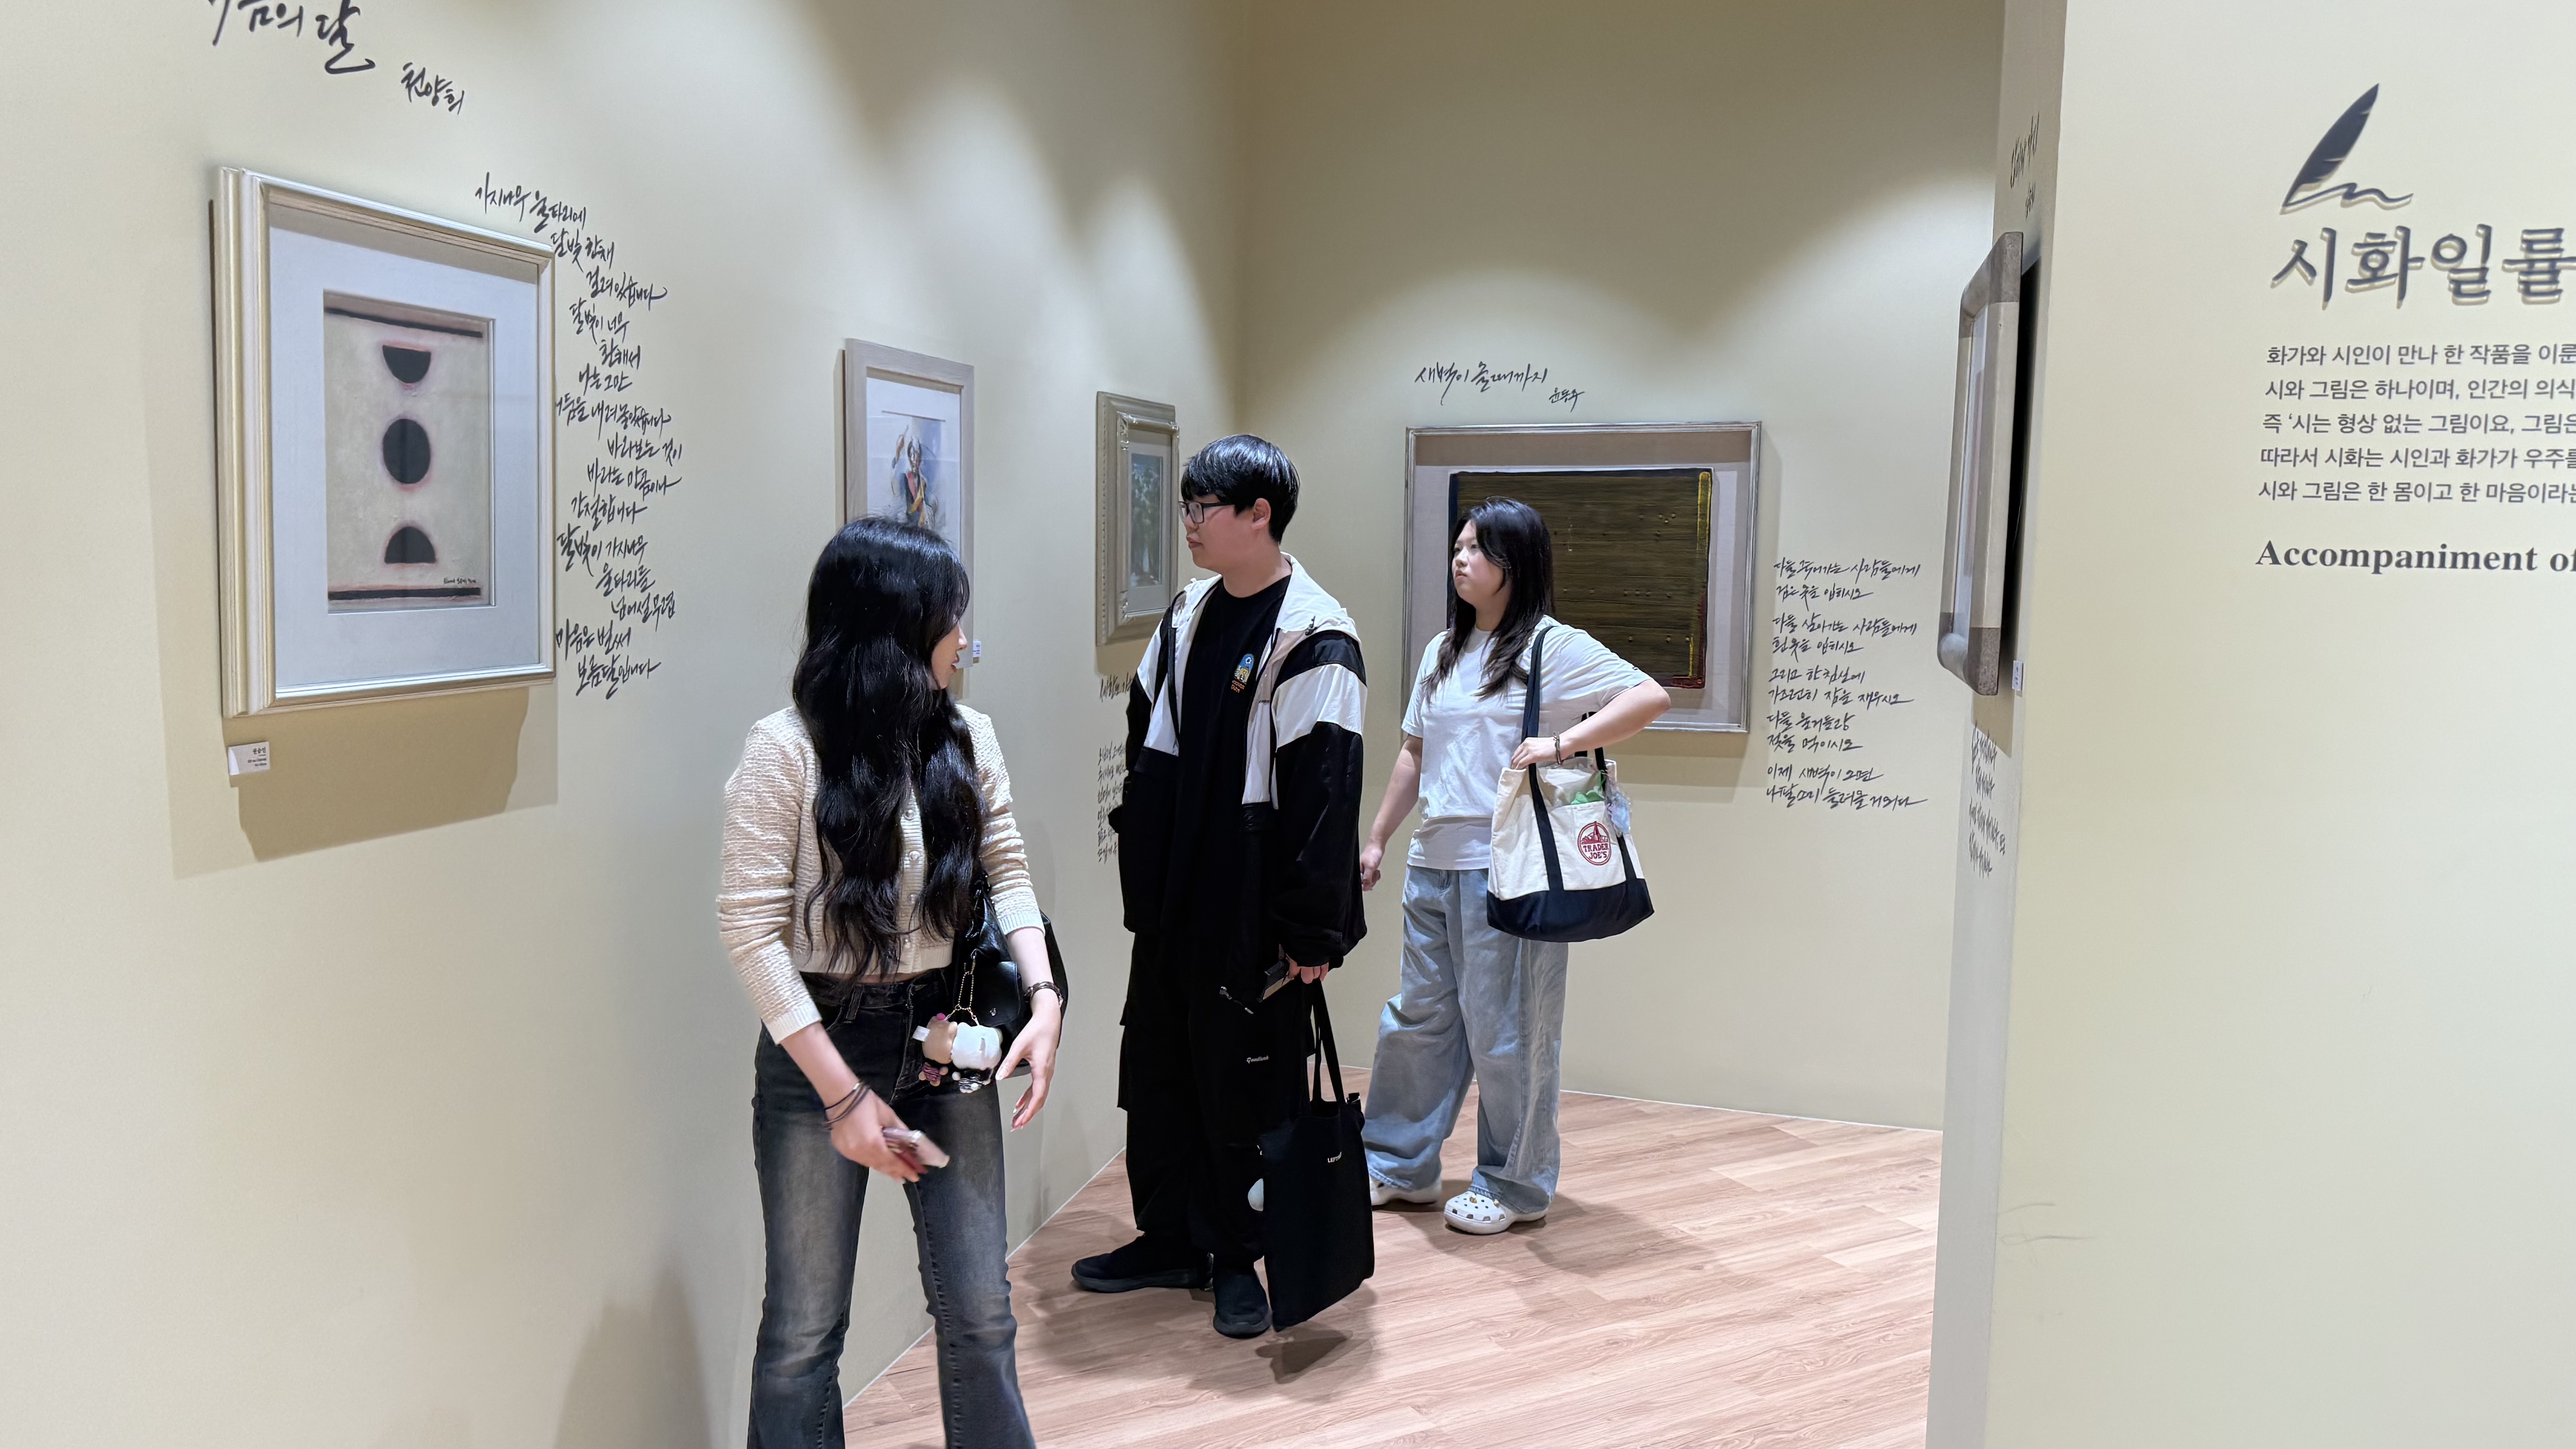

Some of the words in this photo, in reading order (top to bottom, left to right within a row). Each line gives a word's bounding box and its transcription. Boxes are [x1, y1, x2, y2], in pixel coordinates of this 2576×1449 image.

[2271, 224, 2576, 310] 시화일률
[2266, 345, 2327, 366] 화가와
[2332, 344, 2391, 366] 시인이
[2397, 344, 2438, 365] 만나
[2444, 344, 2464, 365] 한
[2469, 343, 2532, 365] 작품을
[2265, 379, 2305, 400] 시와
[2309, 379, 2369, 400] 그림은
[2374, 378, 2460, 400] 하나이며,
[2467, 378, 2528, 400] 인간의
[2534, 378, 2576, 400] 의식
[2262, 413, 2283, 434] 즉
[2337, 413, 2378, 434] 형상
[2383, 413, 2423, 434] 없는
[2428, 413, 2515, 435] 그림이요,
[2260, 447, 2318, 468] 따라서
[2324, 447, 2384, 468] 시화는
[2389, 447, 2451, 469] 시인과
[2455, 447, 2518, 469] 화가가
[2258, 480, 2298, 501] 시와
[2302, 481, 2362, 501] 그림은
[2367, 481, 2388, 502] 한
[2393, 482, 2454, 503] 몸이고
[2459, 482, 2480, 503] 한
[2255, 540, 2539, 575] Accompaniment
[1582, 843, 1610, 853] TRADER
[1588, 851, 1608, 860] JOE'S
